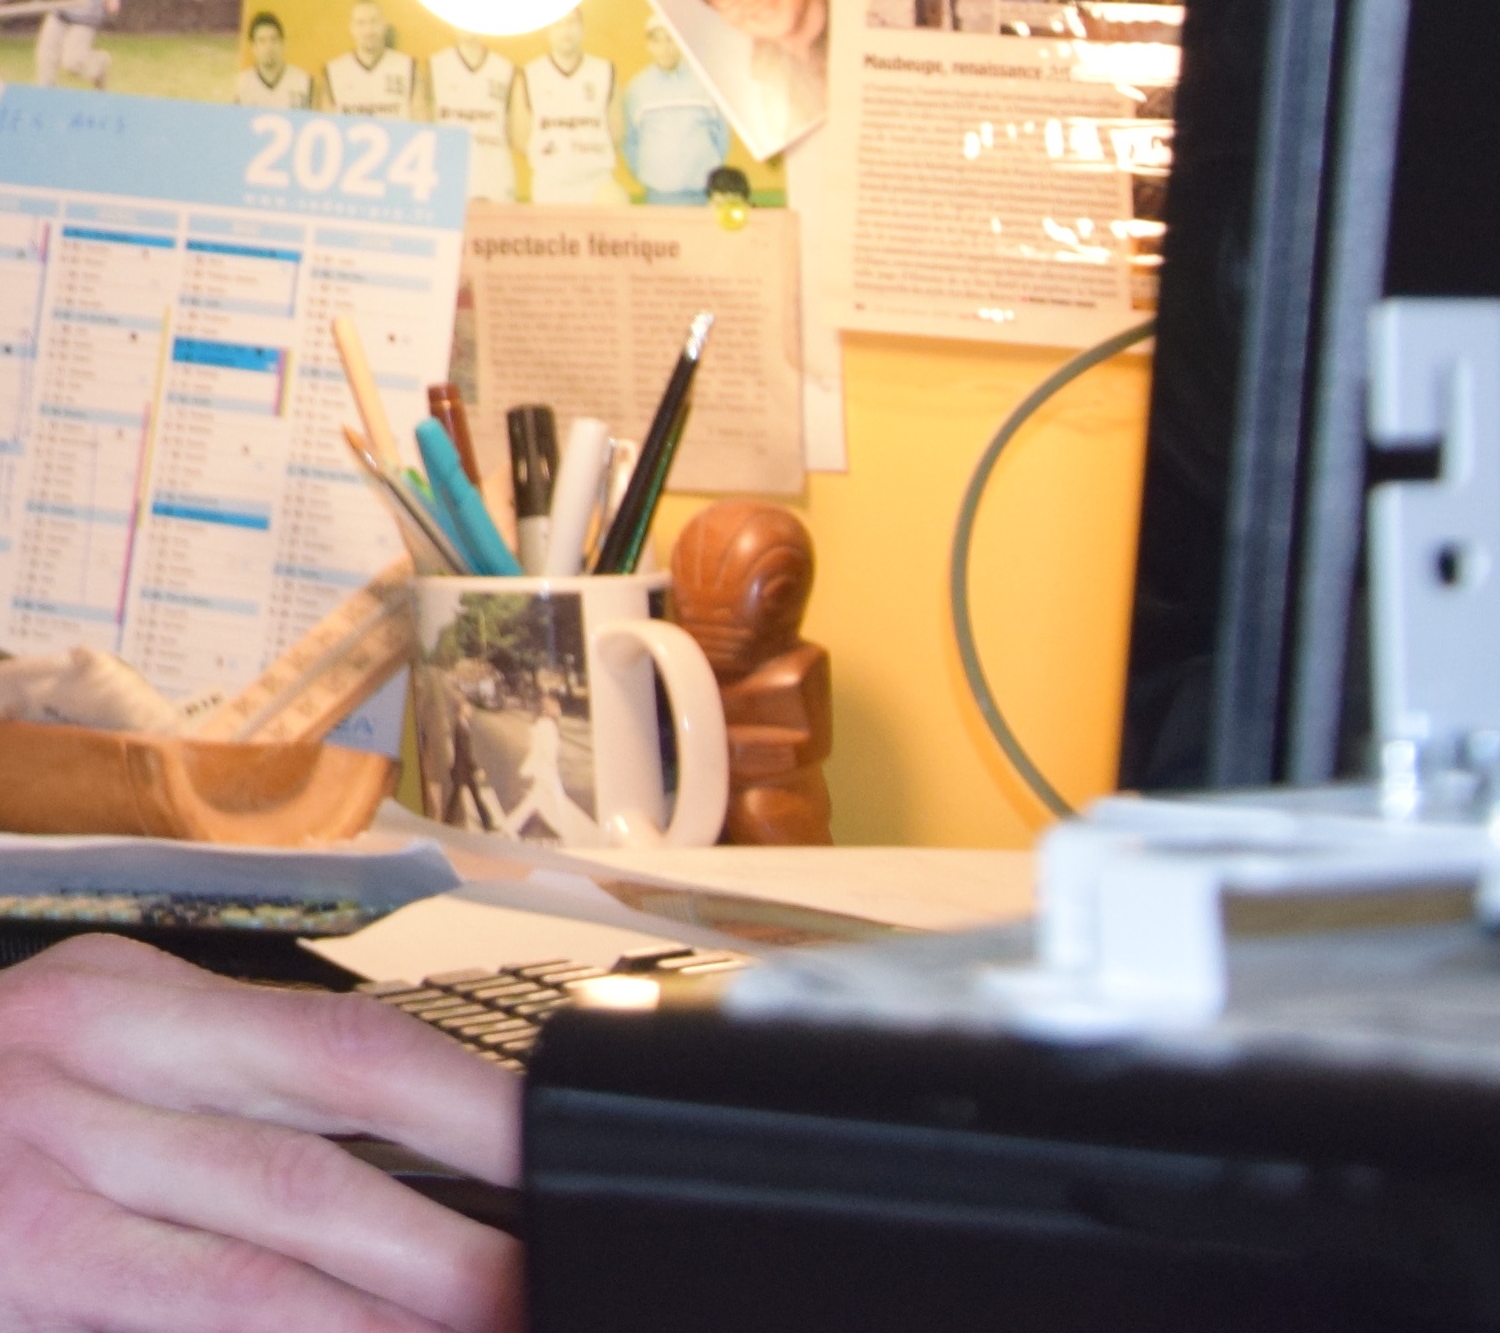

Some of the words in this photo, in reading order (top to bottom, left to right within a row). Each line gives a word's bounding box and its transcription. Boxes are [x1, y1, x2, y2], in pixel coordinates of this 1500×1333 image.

[952, 61, 1044, 81] renaissance
[244, 114, 440, 203] 2024
[473, 235, 580, 261] spectacle
[587, 232, 682, 261] féerique
